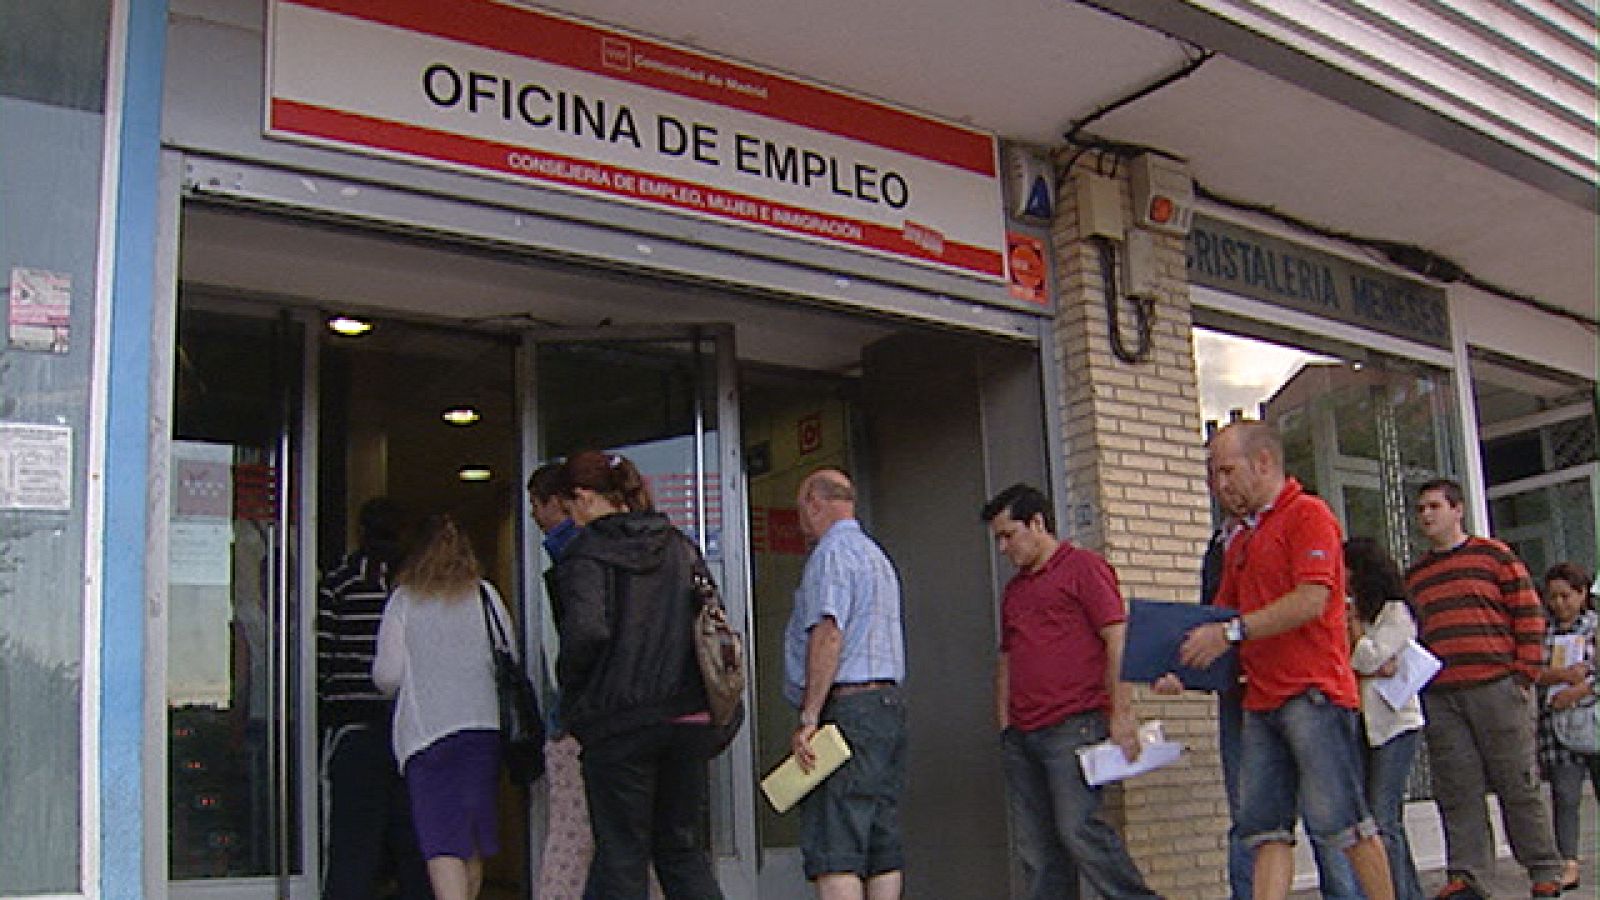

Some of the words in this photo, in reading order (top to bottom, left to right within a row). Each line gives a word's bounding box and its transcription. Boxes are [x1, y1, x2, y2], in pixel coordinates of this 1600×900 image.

[422, 62, 642, 149] OFICINA
[656, 114, 721, 166] DE
[735, 132, 910, 210] EMPLEO
[614, 172, 636, 192] DE
[639, 177, 703, 207] EMPLEO,
[706, 193, 757, 219] MUJER
[759, 204, 770, 220] E
